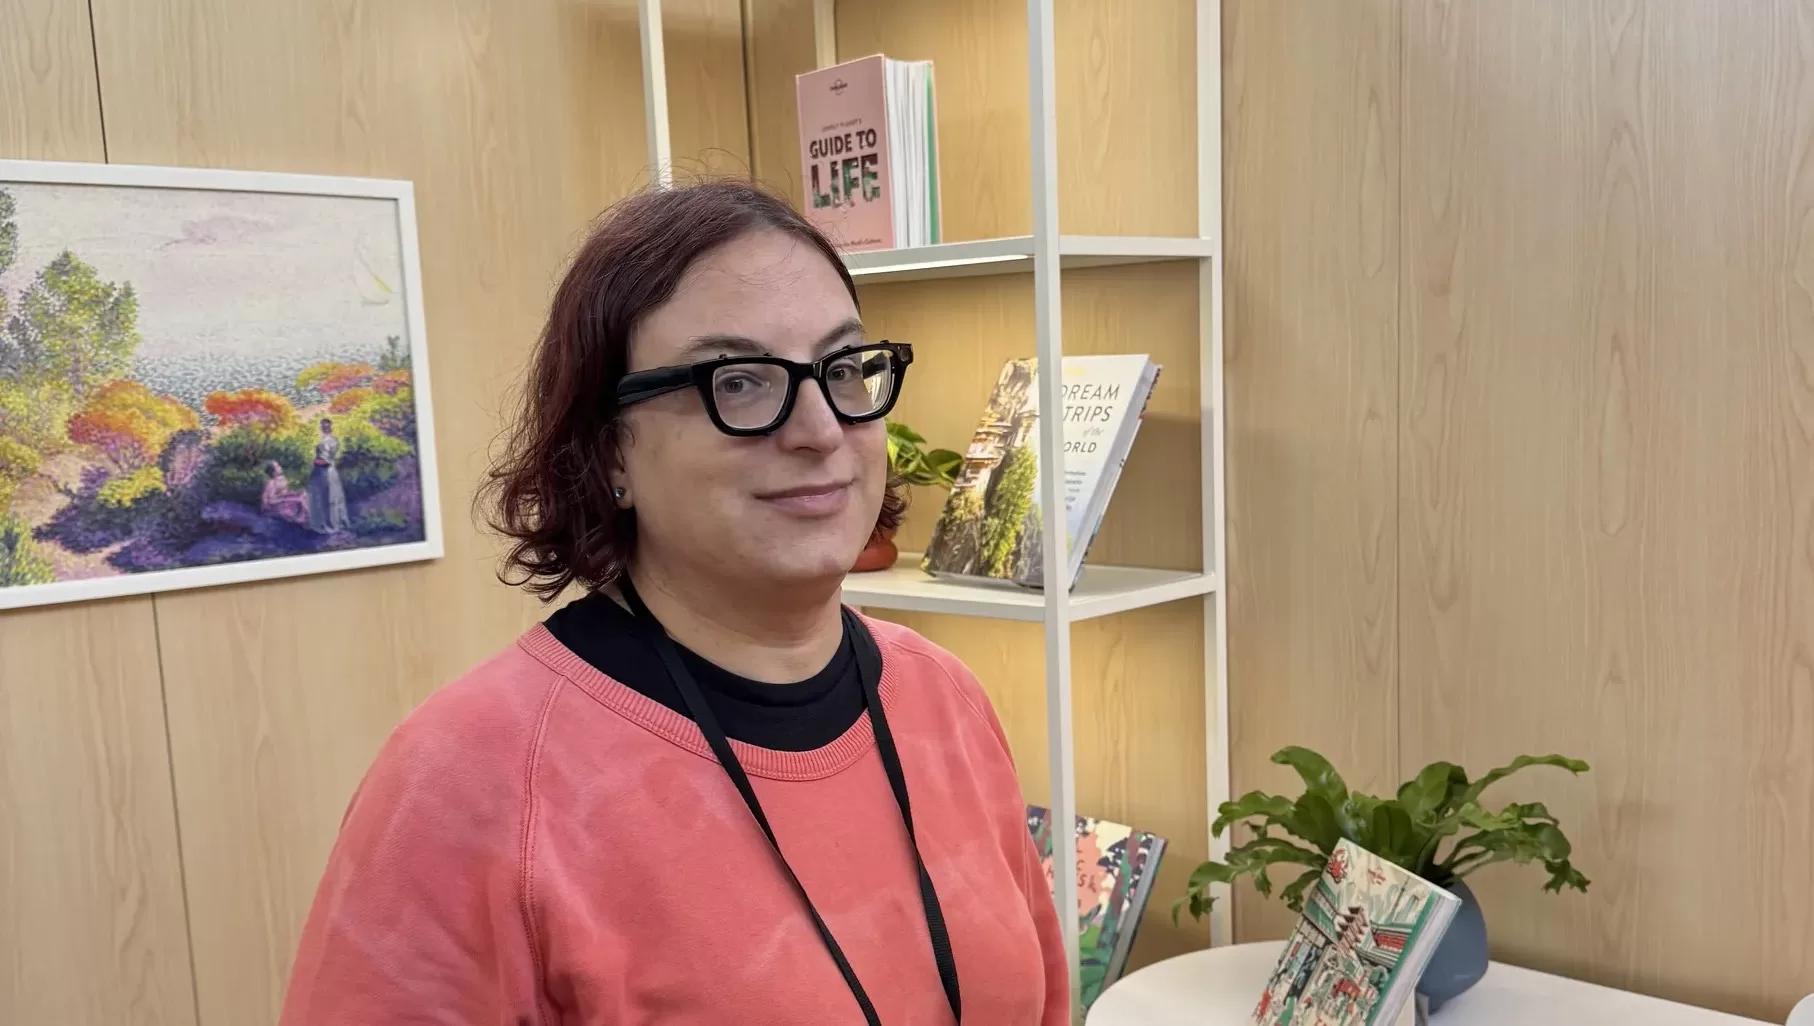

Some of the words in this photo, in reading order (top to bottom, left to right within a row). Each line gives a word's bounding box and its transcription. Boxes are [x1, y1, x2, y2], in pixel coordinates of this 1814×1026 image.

[809, 133, 852, 159] GUIDE
[856, 128, 877, 149] TO
[811, 153, 880, 208] LIFE
[1062, 406, 1113, 422] TRIPS
[1063, 441, 1097, 453] ORLD
